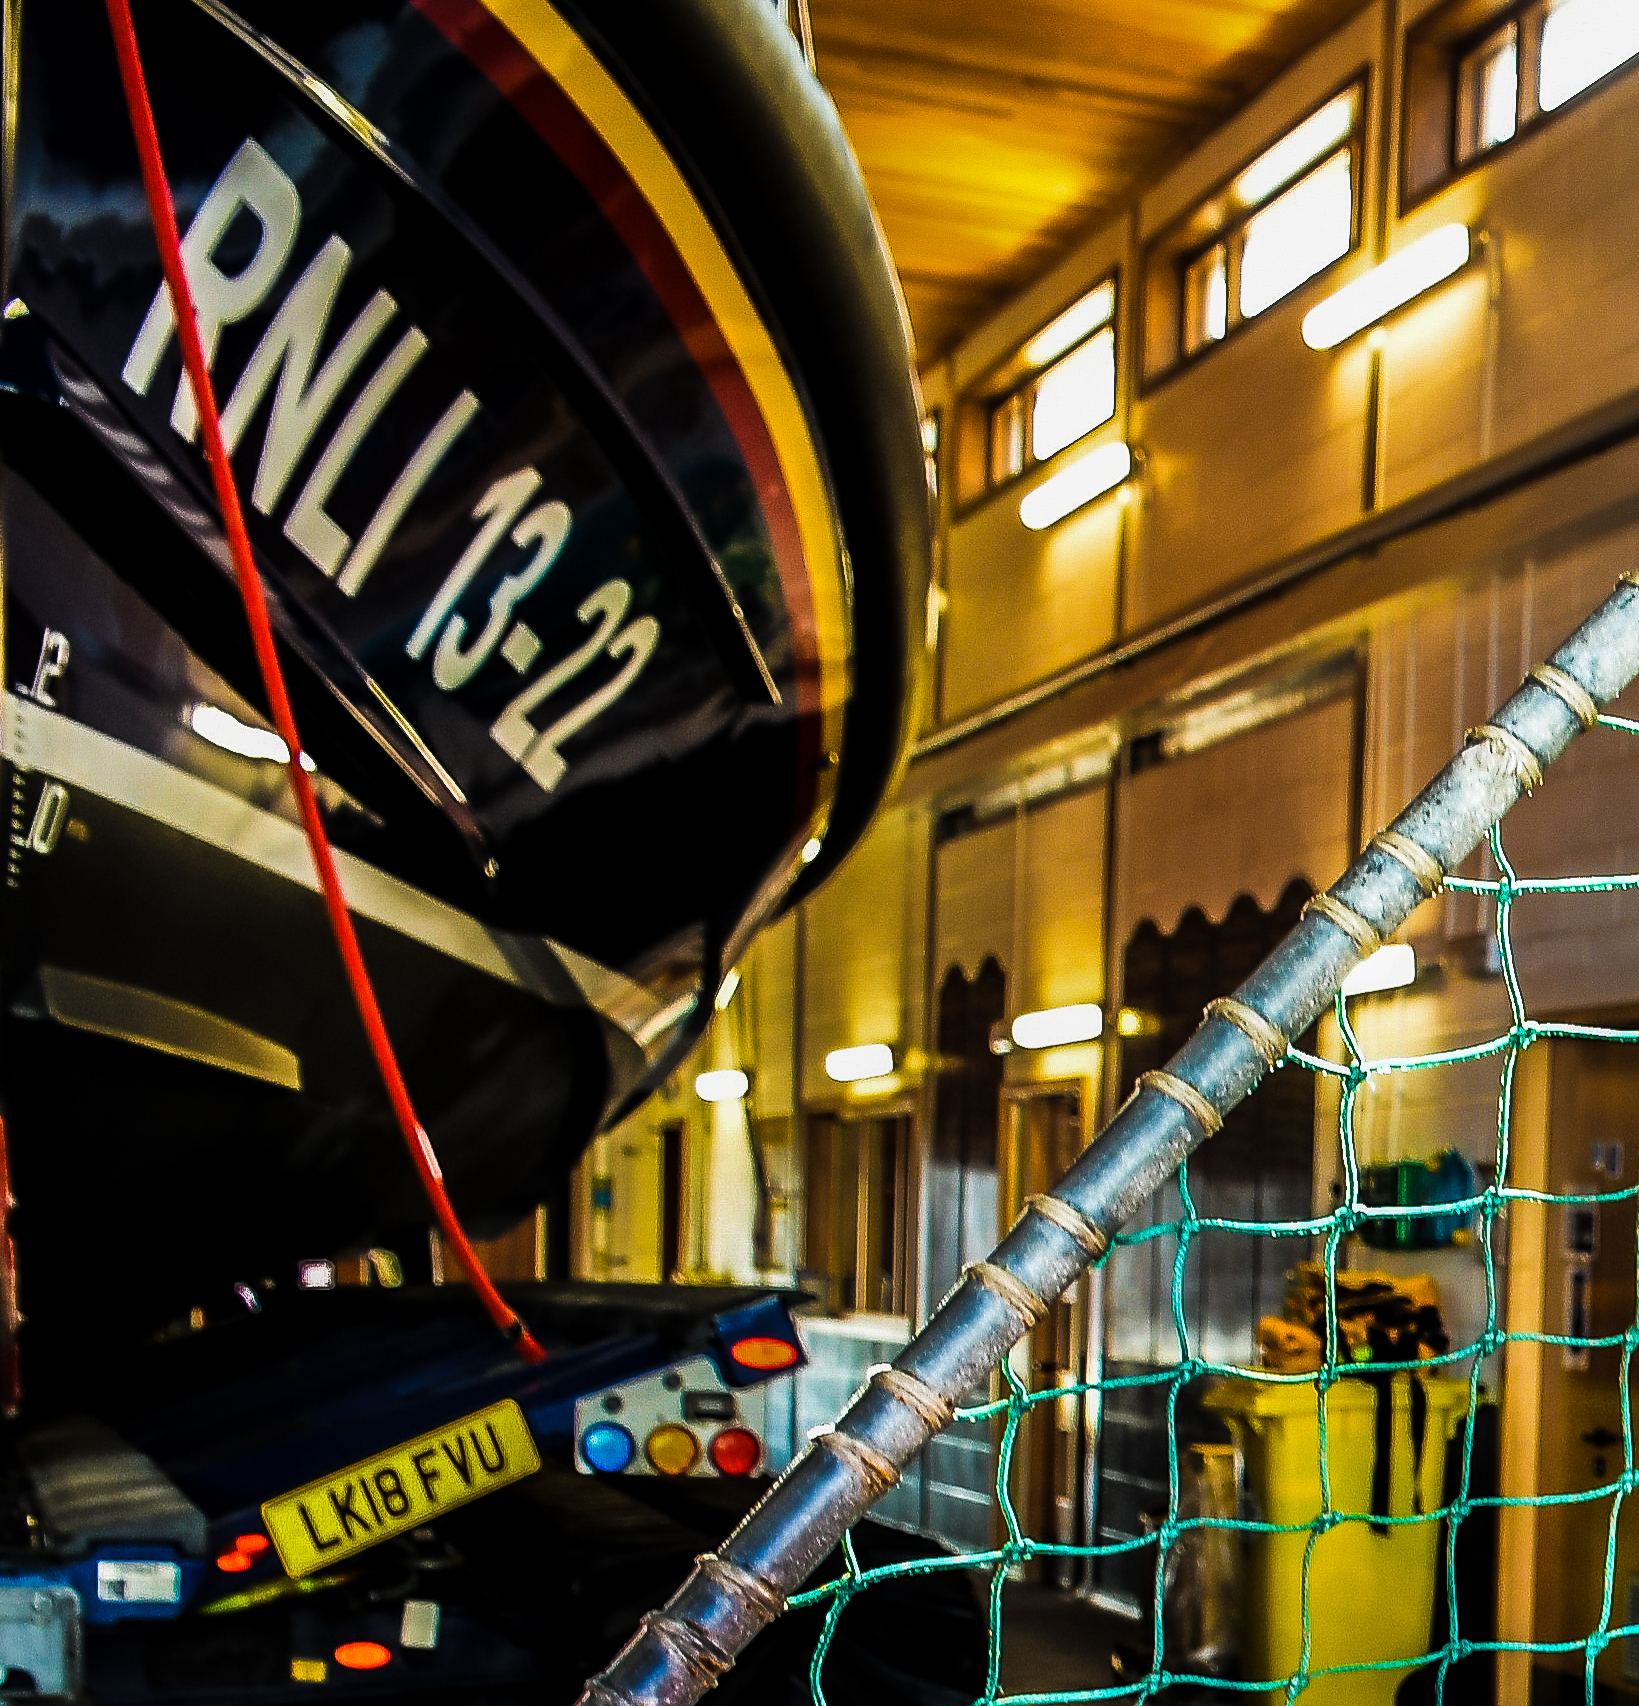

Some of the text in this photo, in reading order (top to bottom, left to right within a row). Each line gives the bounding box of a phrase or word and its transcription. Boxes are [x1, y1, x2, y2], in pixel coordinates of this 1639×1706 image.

[121, 136, 480, 598] RNLI
[405, 466, 660, 792] 13-22
[297, 1422, 506, 1551] LK18 FVU
